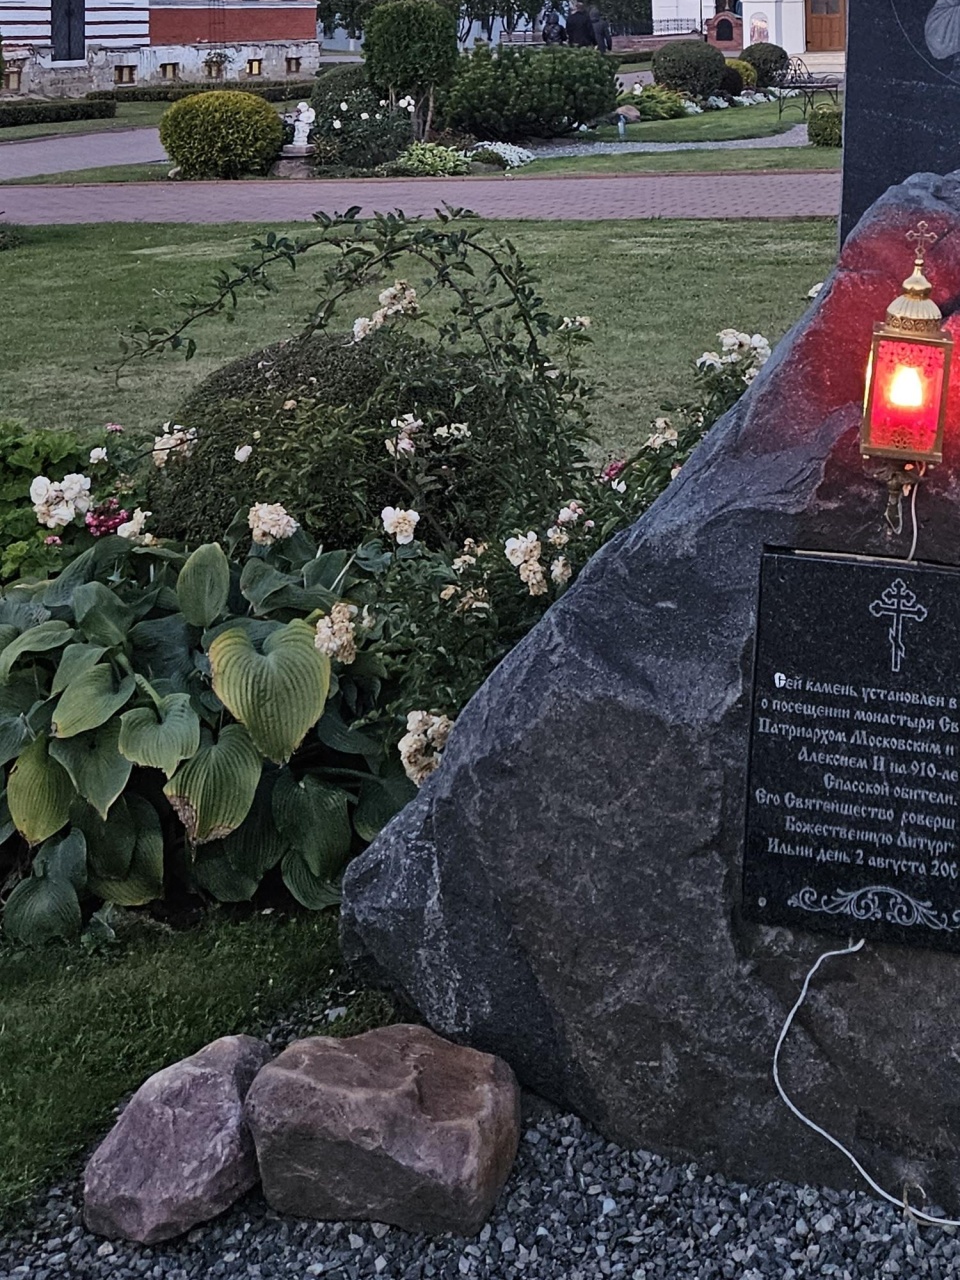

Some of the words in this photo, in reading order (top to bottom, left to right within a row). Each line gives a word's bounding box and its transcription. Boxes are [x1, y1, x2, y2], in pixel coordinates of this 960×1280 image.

[774, 672, 802, 690] Сей
[805, 678, 858, 697] камень
[861, 687, 945, 707] установлен
[948, 697, 957, 709] в
[761, 698, 768, 709] о
[772, 699, 850, 719] посещении
[853, 711, 935, 733] монастыря
[758, 717, 847, 745] Патриархом
[850, 729, 942, 755] Московским
[945, 743, 955, 756] и
[798, 746, 868, 770] Алексием
[889, 762, 908, 775] на
[911, 761, 959, 782] 910-ле
[823, 773, 890, 797] Спасской
[893, 785, 958, 806] обители.
[755, 788, 781, 806] Его
[784, 791, 895, 821] Святейшество
[900, 811, 956, 832] соверш
[785, 815, 893, 847] Божественную
[897, 831, 955, 857] Литург
[767, 837, 813, 858] Ильин
[816, 848, 851, 864] день
[854, 849, 865, 865] 2
[868, 855, 928, 876] августа
[930, 860, 959, 880] 200
